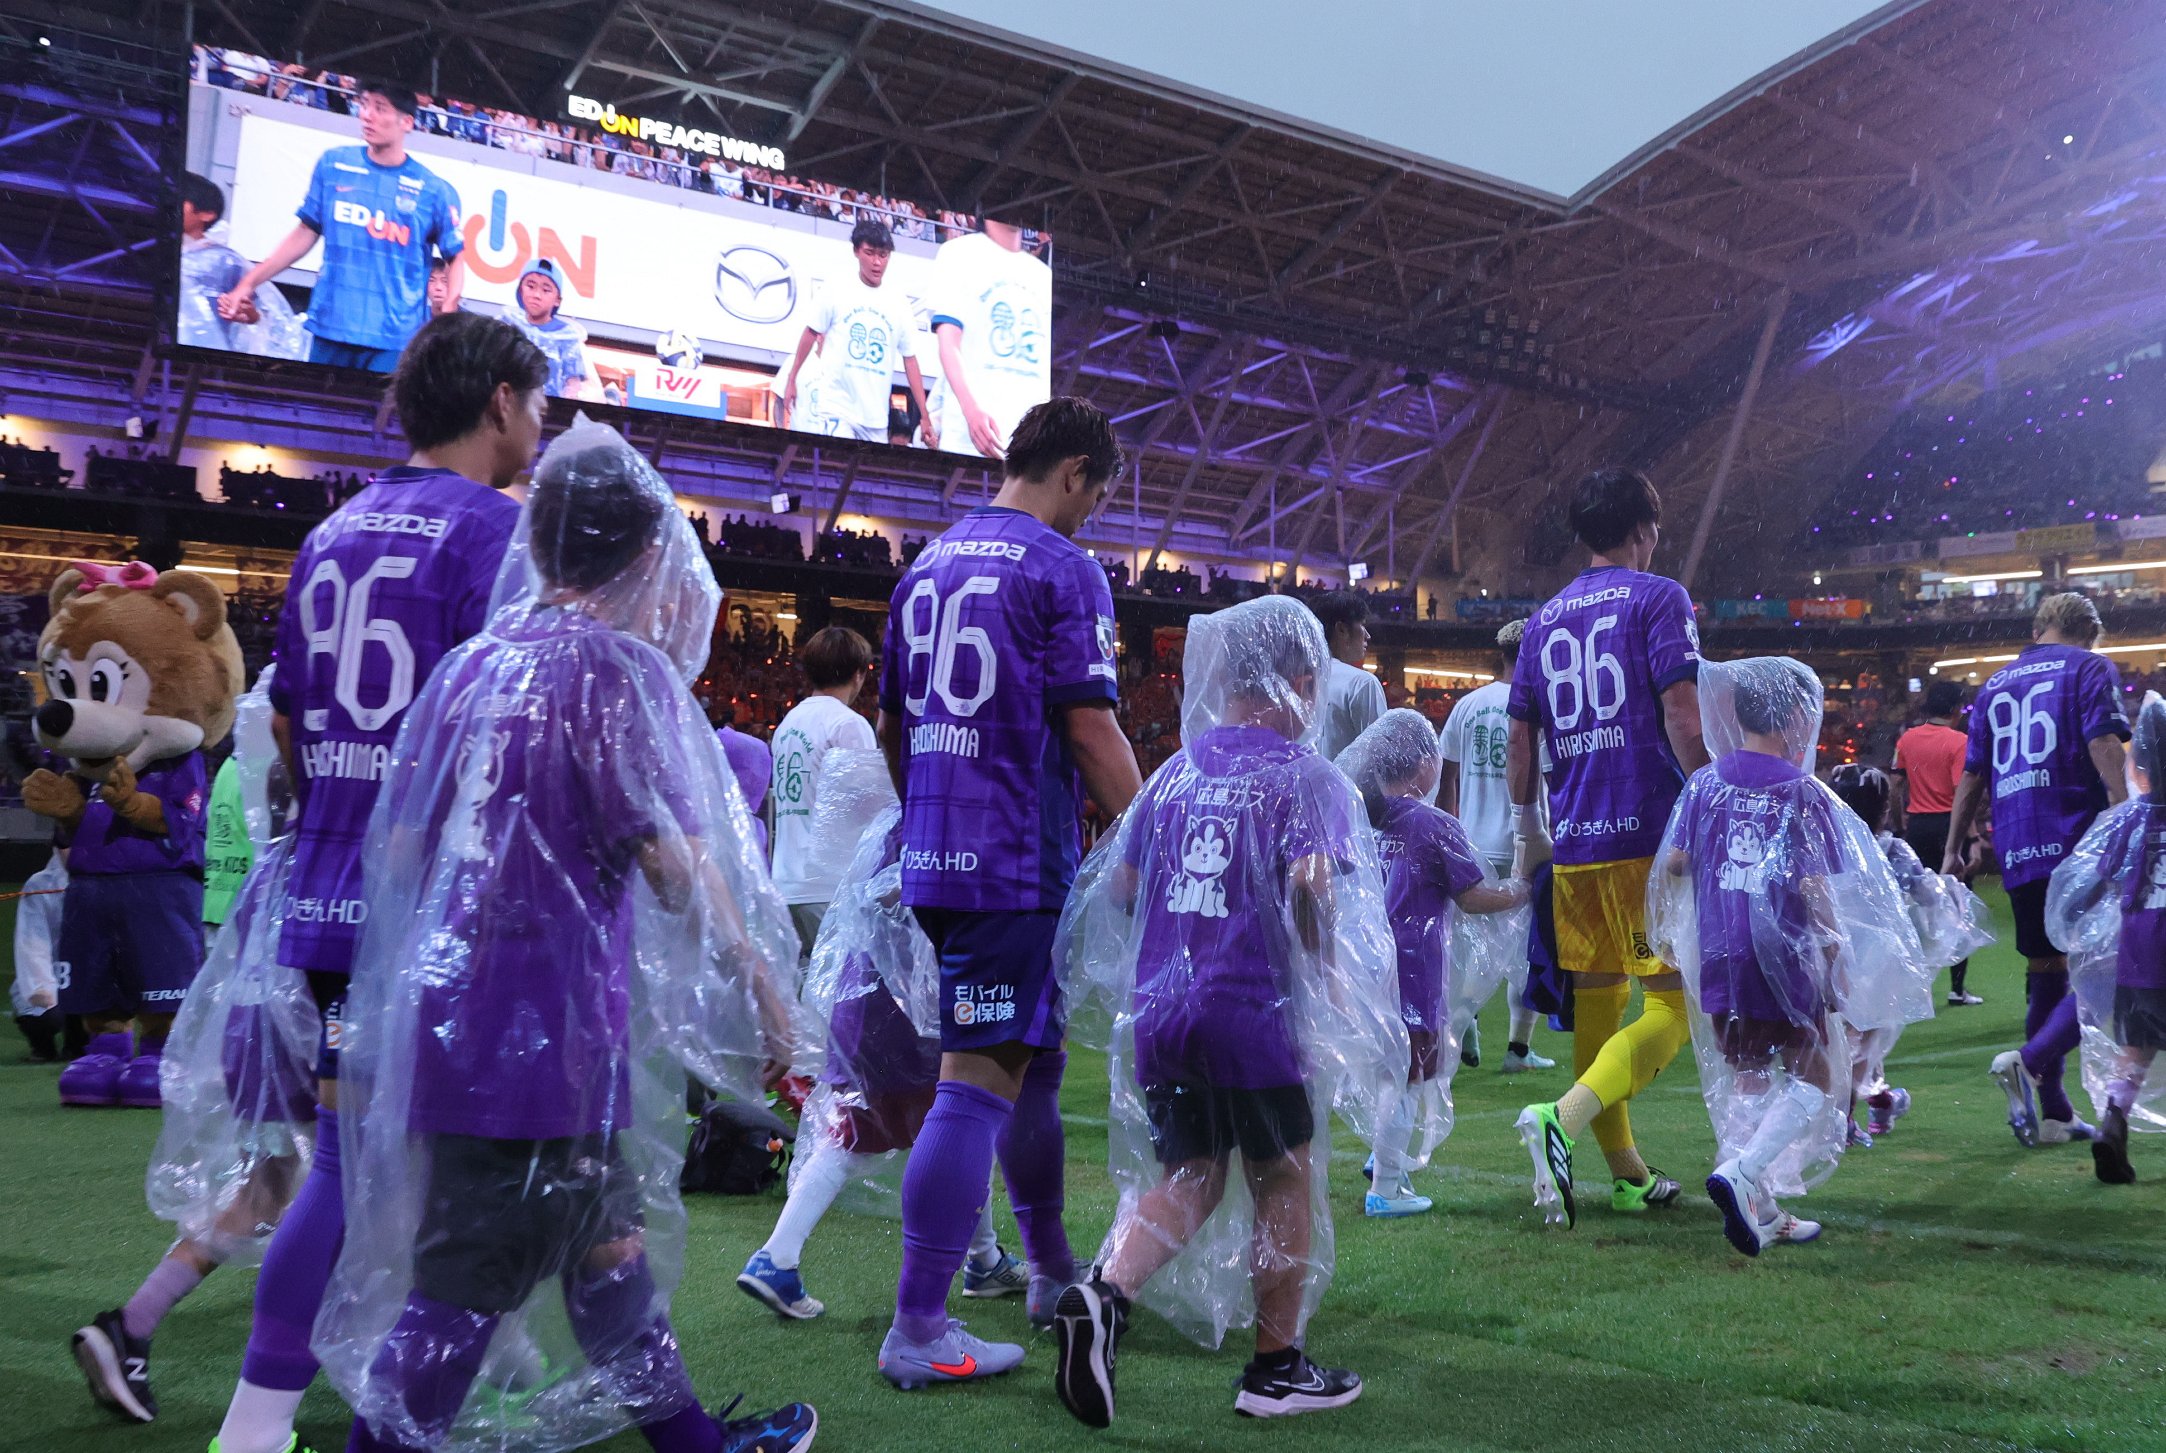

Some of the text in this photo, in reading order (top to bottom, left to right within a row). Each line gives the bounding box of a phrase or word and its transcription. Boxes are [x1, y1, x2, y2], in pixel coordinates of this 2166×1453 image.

[639, 117, 721, 156] PEACE
[720, 136, 785, 171] WING
[940, 540, 1027, 561] mazda
[1565, 586, 1631, 612] mazda
[901, 575, 1001, 718] 86
[1540, 614, 1627, 731] 86
[2008, 659, 2067, 681] mazda
[1986, 680, 2058, 776] 86
[954, 983, 1015, 1002] モバイル
